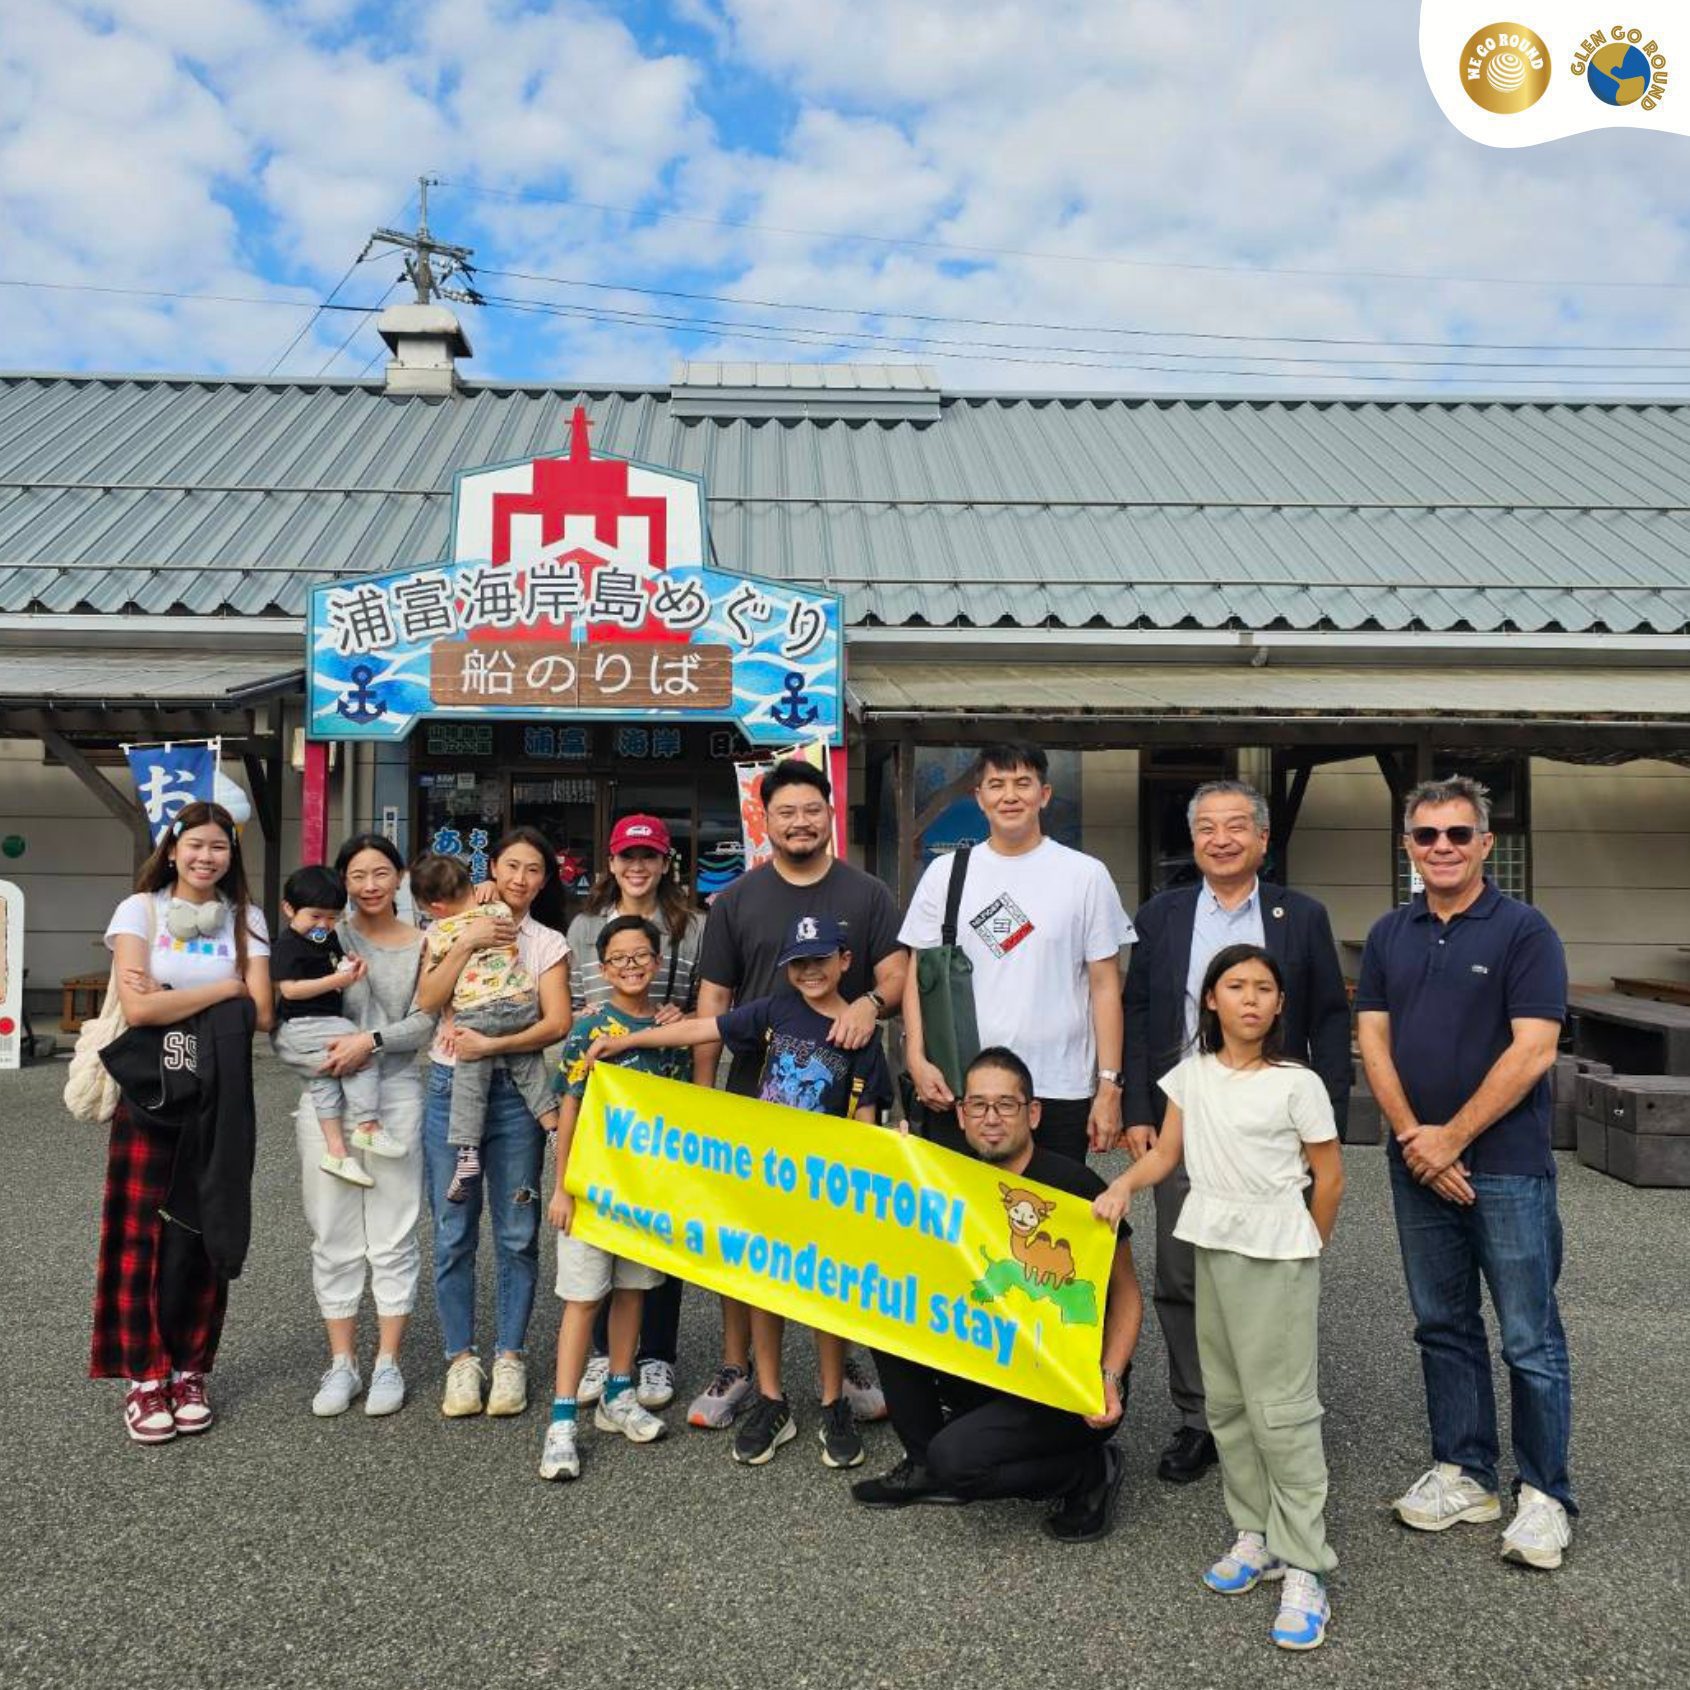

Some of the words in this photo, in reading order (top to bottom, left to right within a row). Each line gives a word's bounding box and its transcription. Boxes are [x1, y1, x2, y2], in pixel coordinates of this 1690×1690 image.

[330, 561, 828, 657] 浦富海岸島めぐり
[460, 649, 702, 697] 船のりば
[604, 1104, 753, 1180] Welcome
[763, 1148, 797, 1192] to
[805, 1156, 965, 1243] TOTTORI
[685, 1220, 705, 1254] a
[718, 1228, 917, 1325] wonderful
[929, 1294, 1019, 1366] stay
